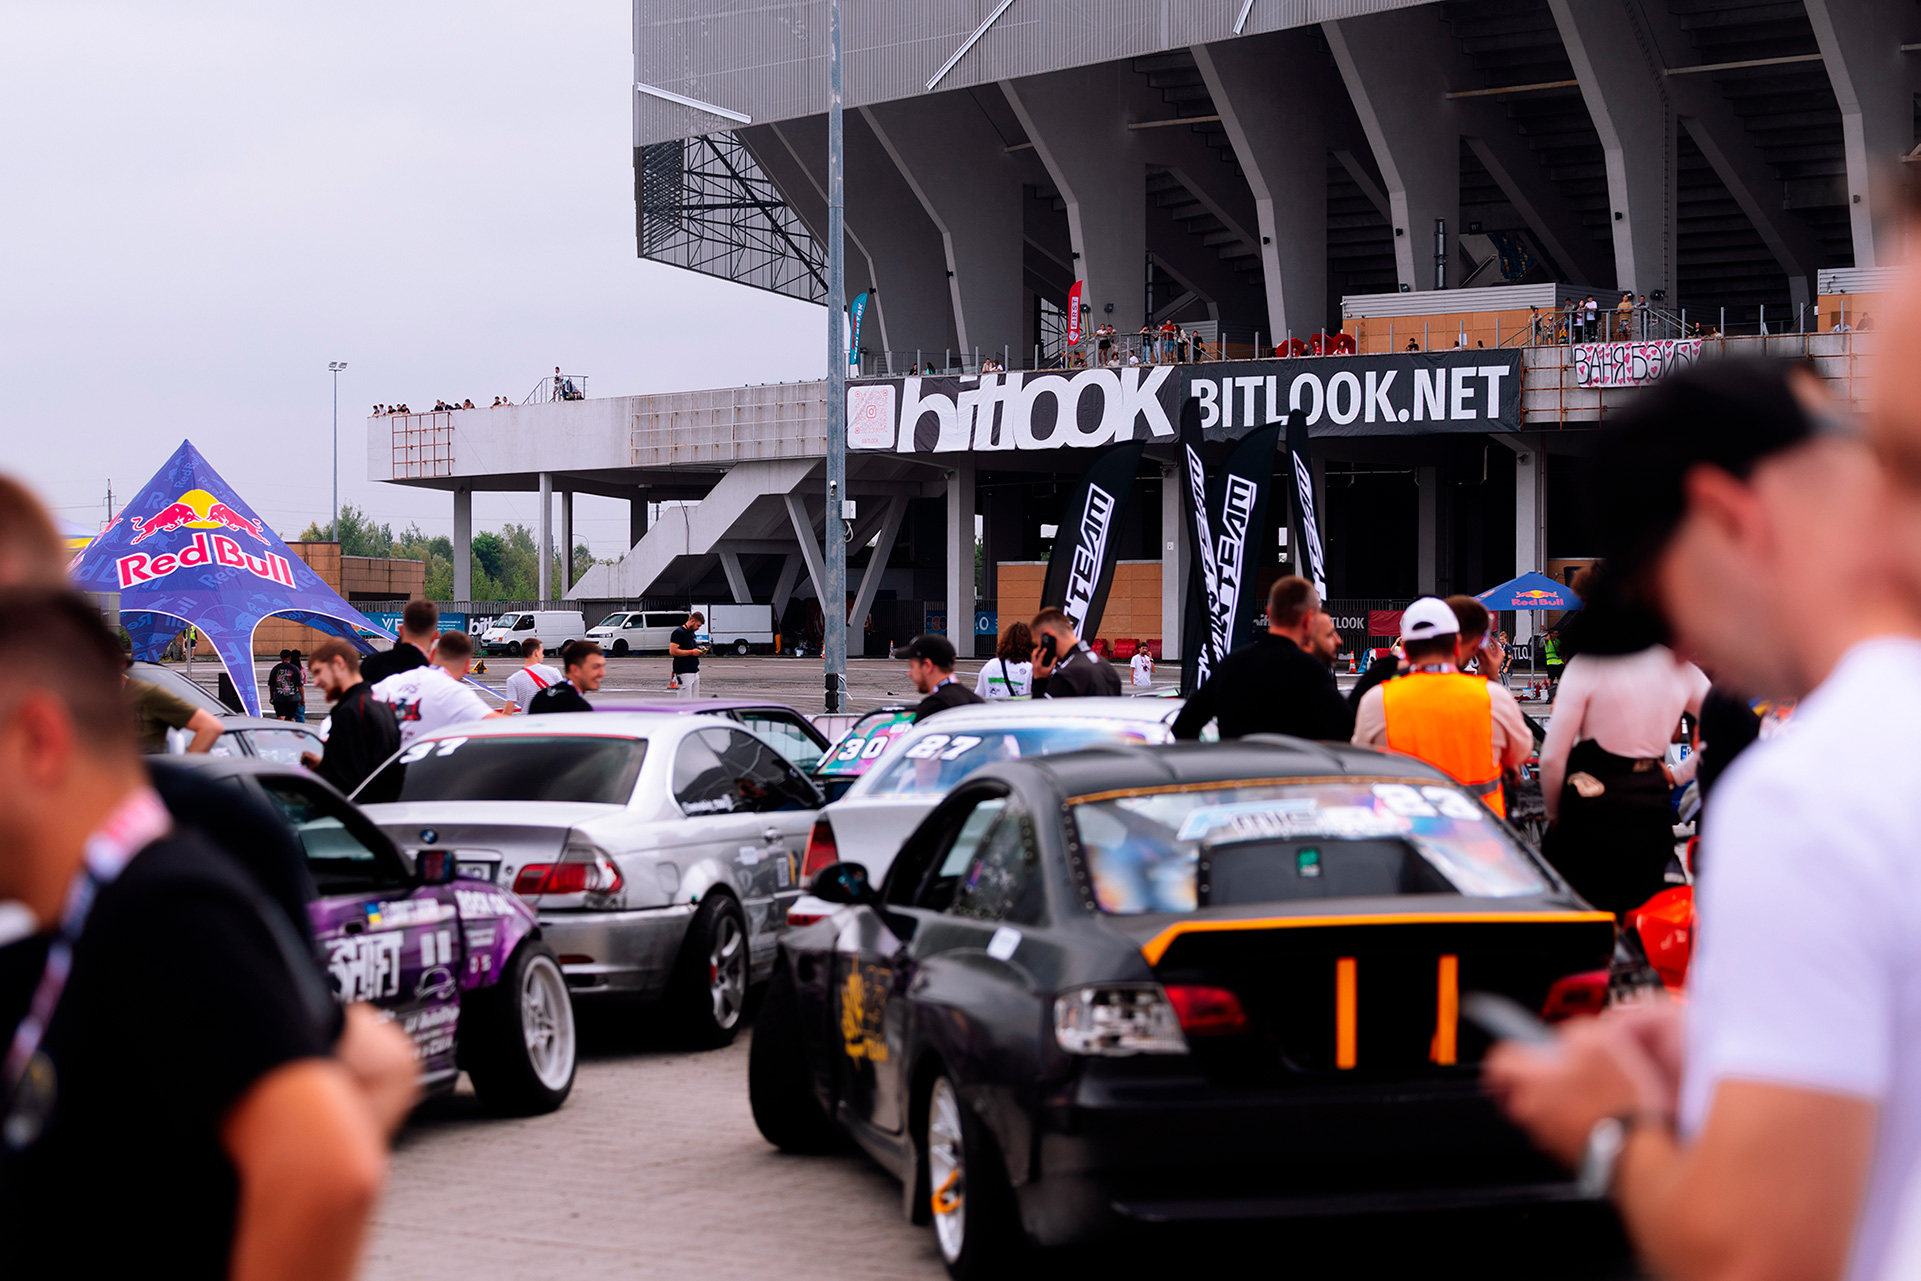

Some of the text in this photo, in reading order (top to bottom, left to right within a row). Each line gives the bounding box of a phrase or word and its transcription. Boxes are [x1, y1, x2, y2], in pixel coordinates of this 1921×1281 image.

[1574, 346, 1625, 385] ВАНЯ
[897, 365, 1175, 453] bitlook
[1191, 365, 1510, 429] BITLOOK.NET
[1065, 483, 1115, 604] TEAM
[116, 532, 212, 589] Red
[211, 533, 296, 589] Bull
[1511, 598, 1564, 606] Red Bull
[468, 616, 498, 635] bitl
[1330, 616, 1365, 629] TLOOK
[837, 735, 890, 761] 30
[904, 733, 983, 761] 87
